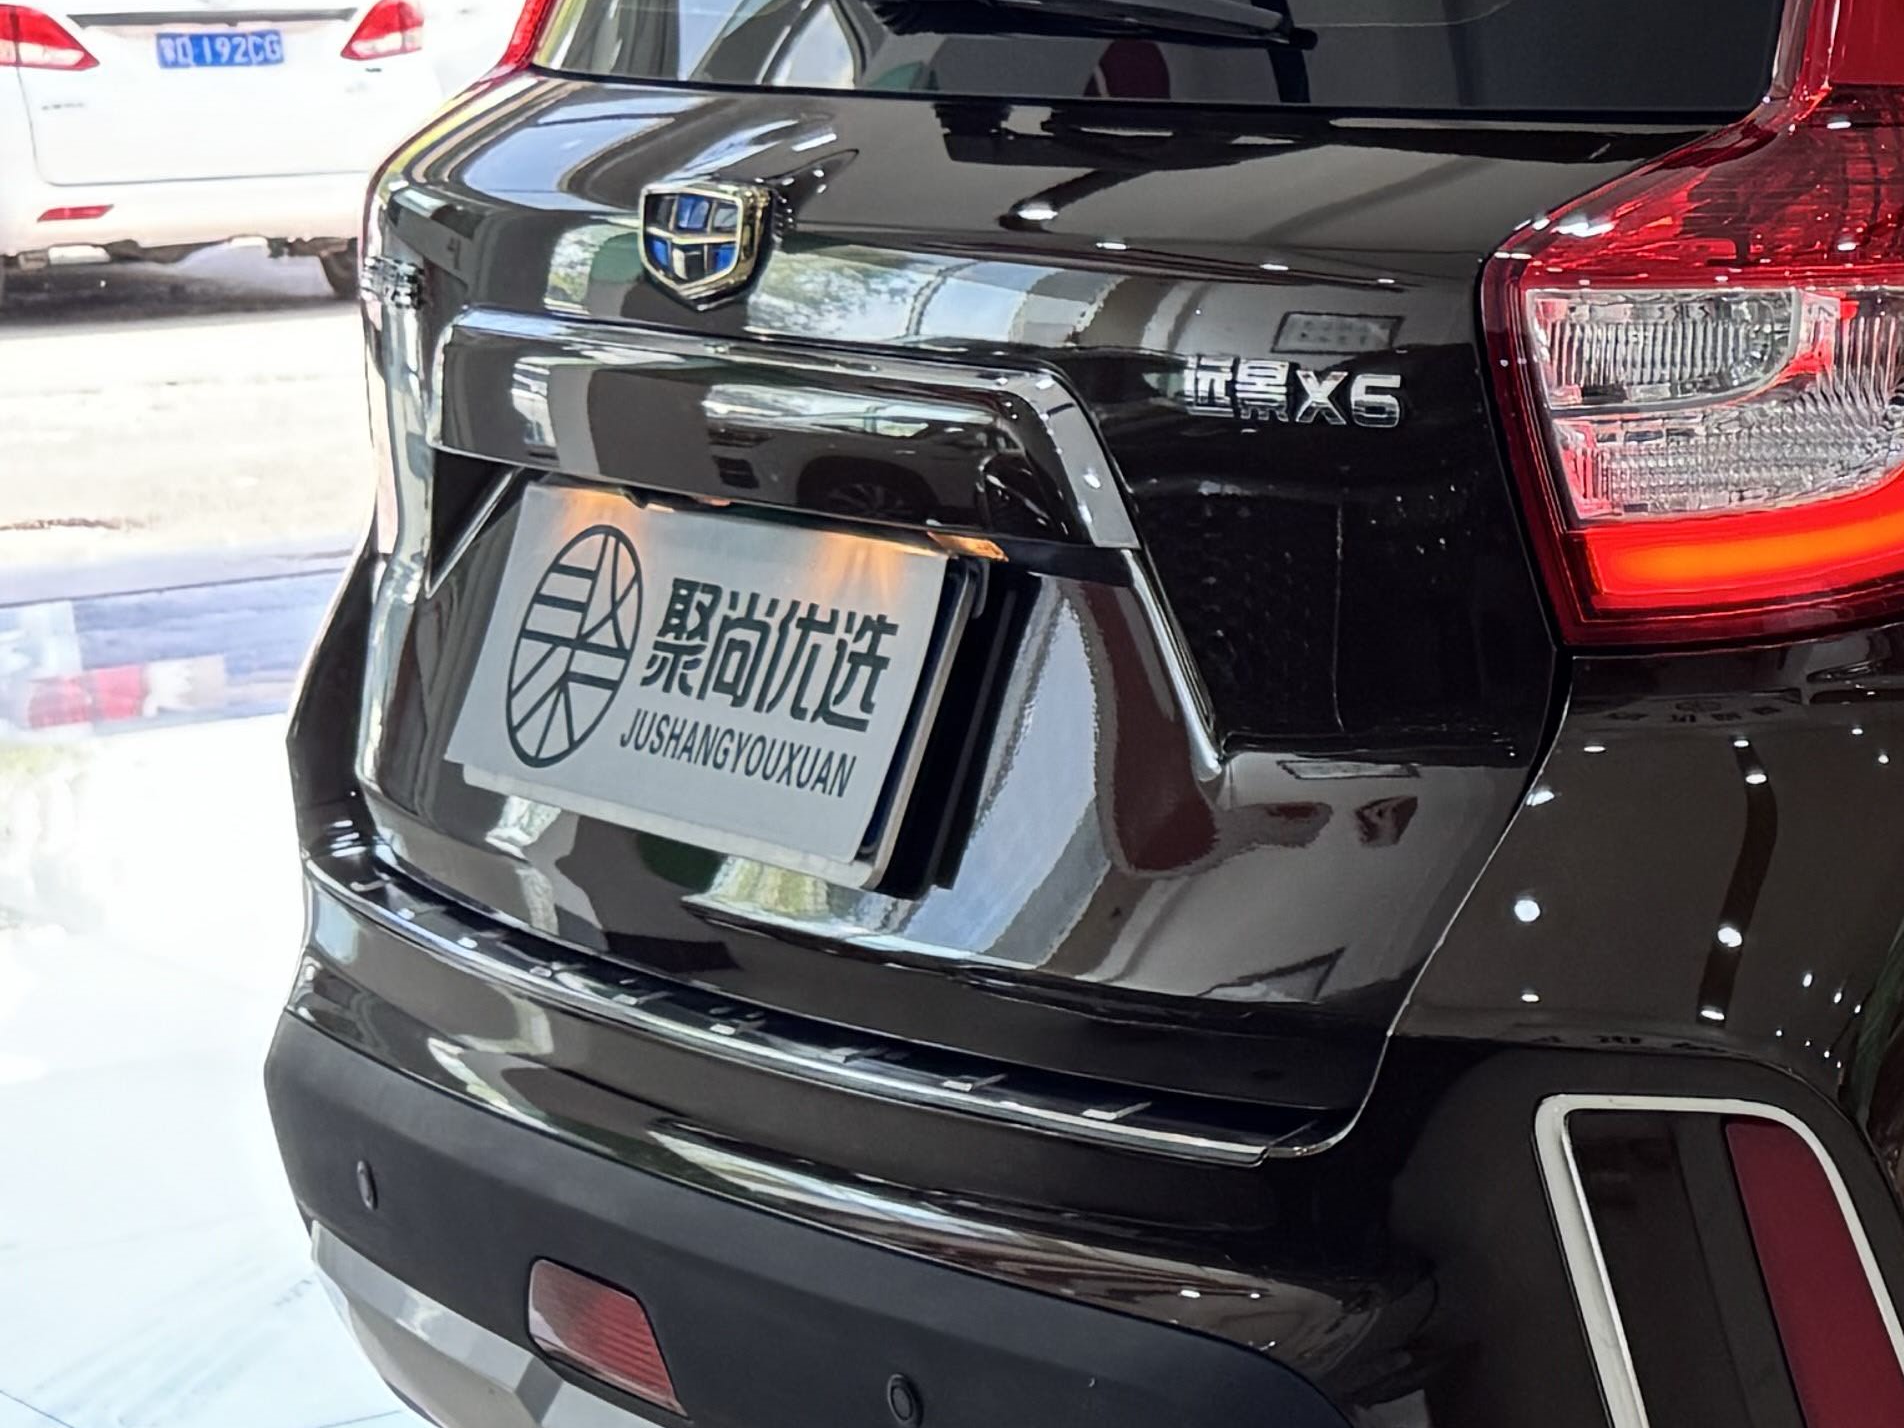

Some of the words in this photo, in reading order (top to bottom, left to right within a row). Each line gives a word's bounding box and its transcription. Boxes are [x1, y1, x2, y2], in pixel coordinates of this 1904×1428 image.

[1183, 355, 1402, 429] 远景X6
[640, 577, 899, 733] 聚尚优选
[620, 708, 858, 799] JUSHANGYOUXUAN
